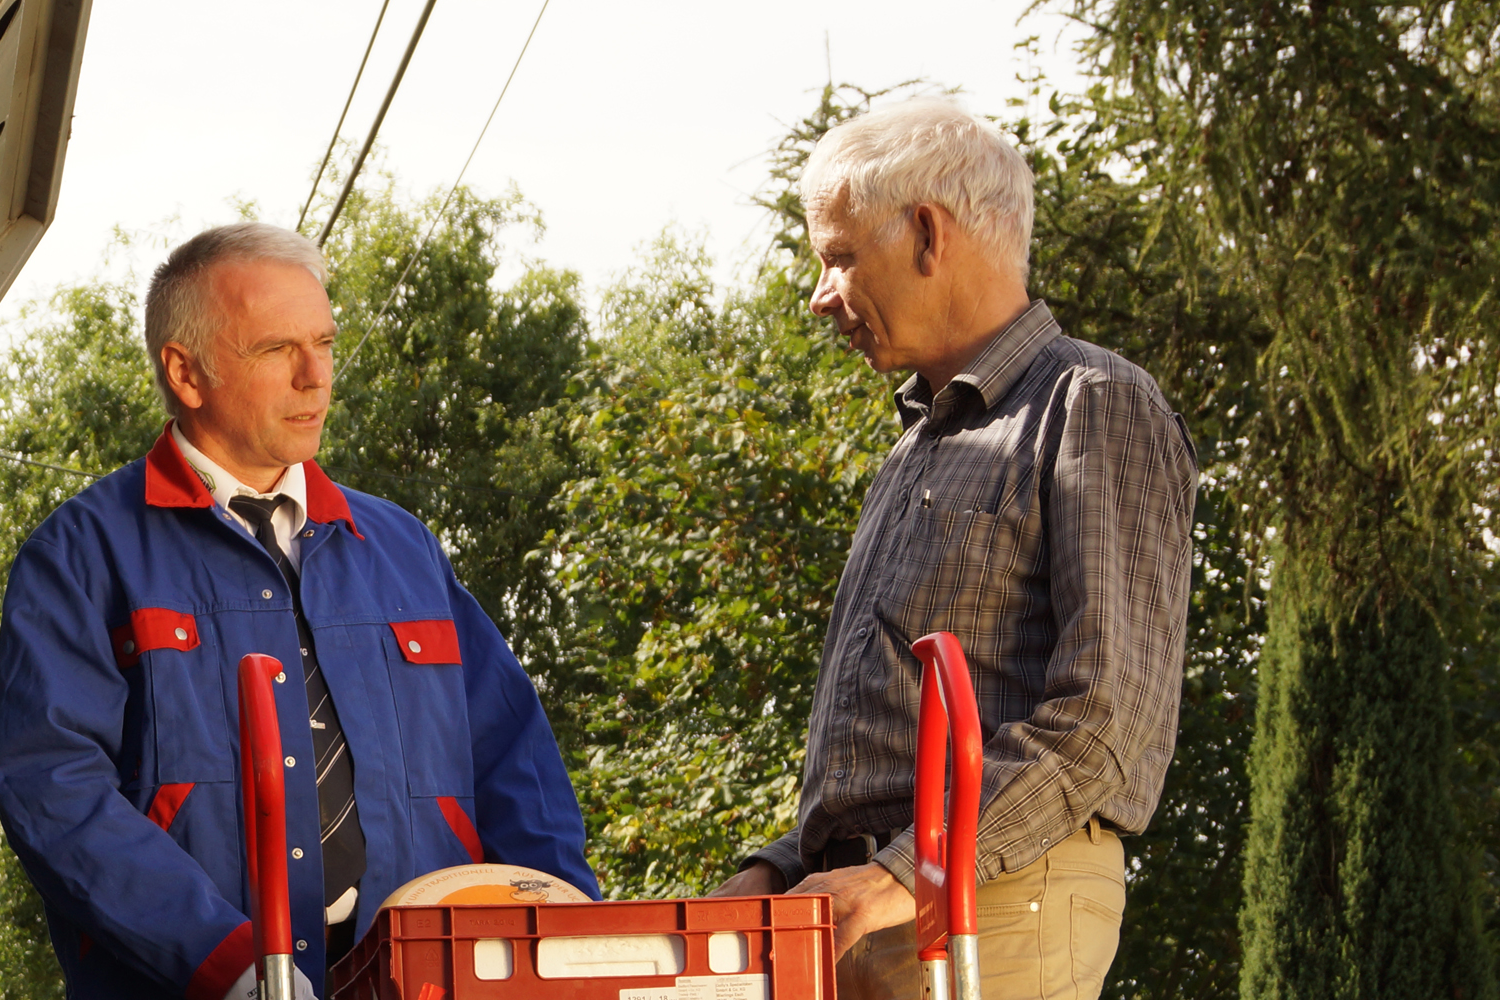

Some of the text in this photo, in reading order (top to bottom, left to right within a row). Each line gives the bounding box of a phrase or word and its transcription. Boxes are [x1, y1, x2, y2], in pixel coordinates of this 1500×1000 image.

[408, 868, 495, 902] UND TRADITIONELL
[513, 870, 534, 879] AUS
[551, 882, 568, 893] DER
[416, 919, 432, 928] E2
